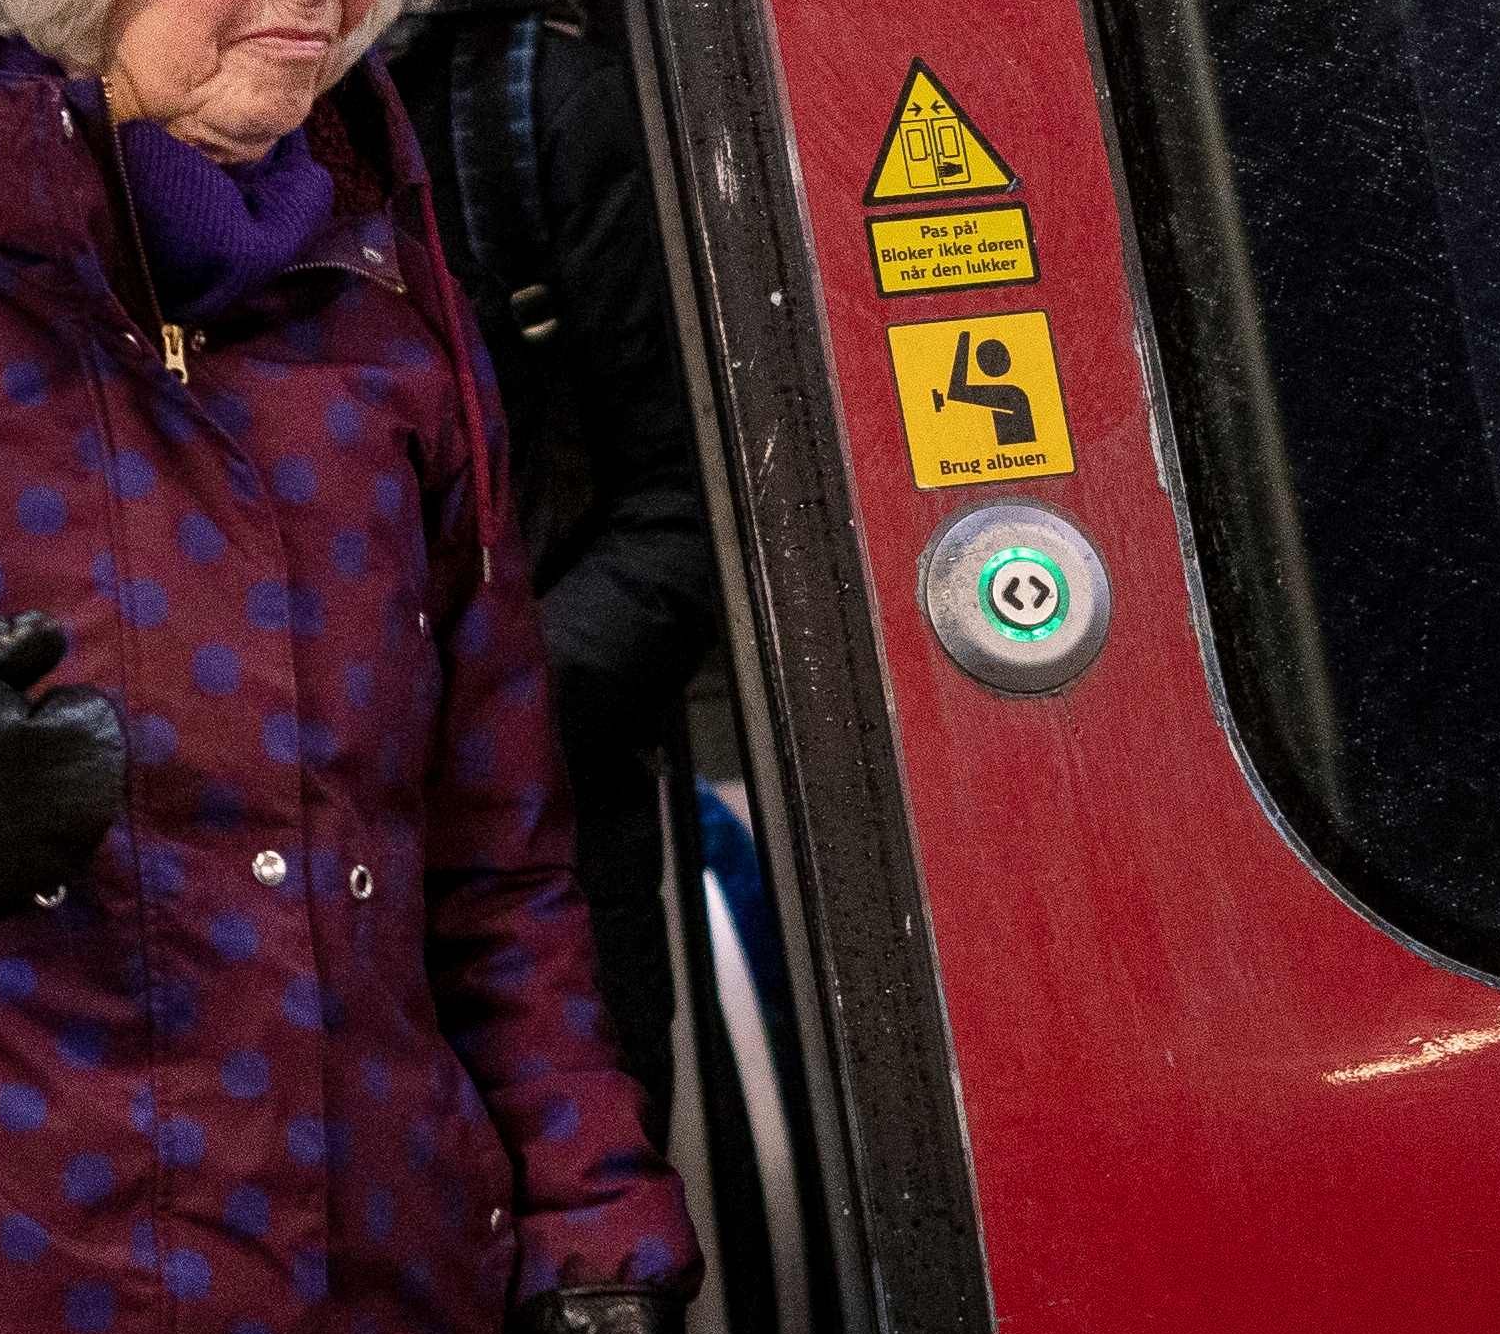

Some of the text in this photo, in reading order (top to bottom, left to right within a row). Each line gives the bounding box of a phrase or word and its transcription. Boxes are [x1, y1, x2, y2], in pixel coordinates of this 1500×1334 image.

[920, 220, 979, 240] Pas på!
[881, 246, 935, 263] Bloker
[977, 238, 1025, 254] døren
[900, 257, 1018, 281] når den lukker
[939, 452, 1048, 476] Brug albuen
